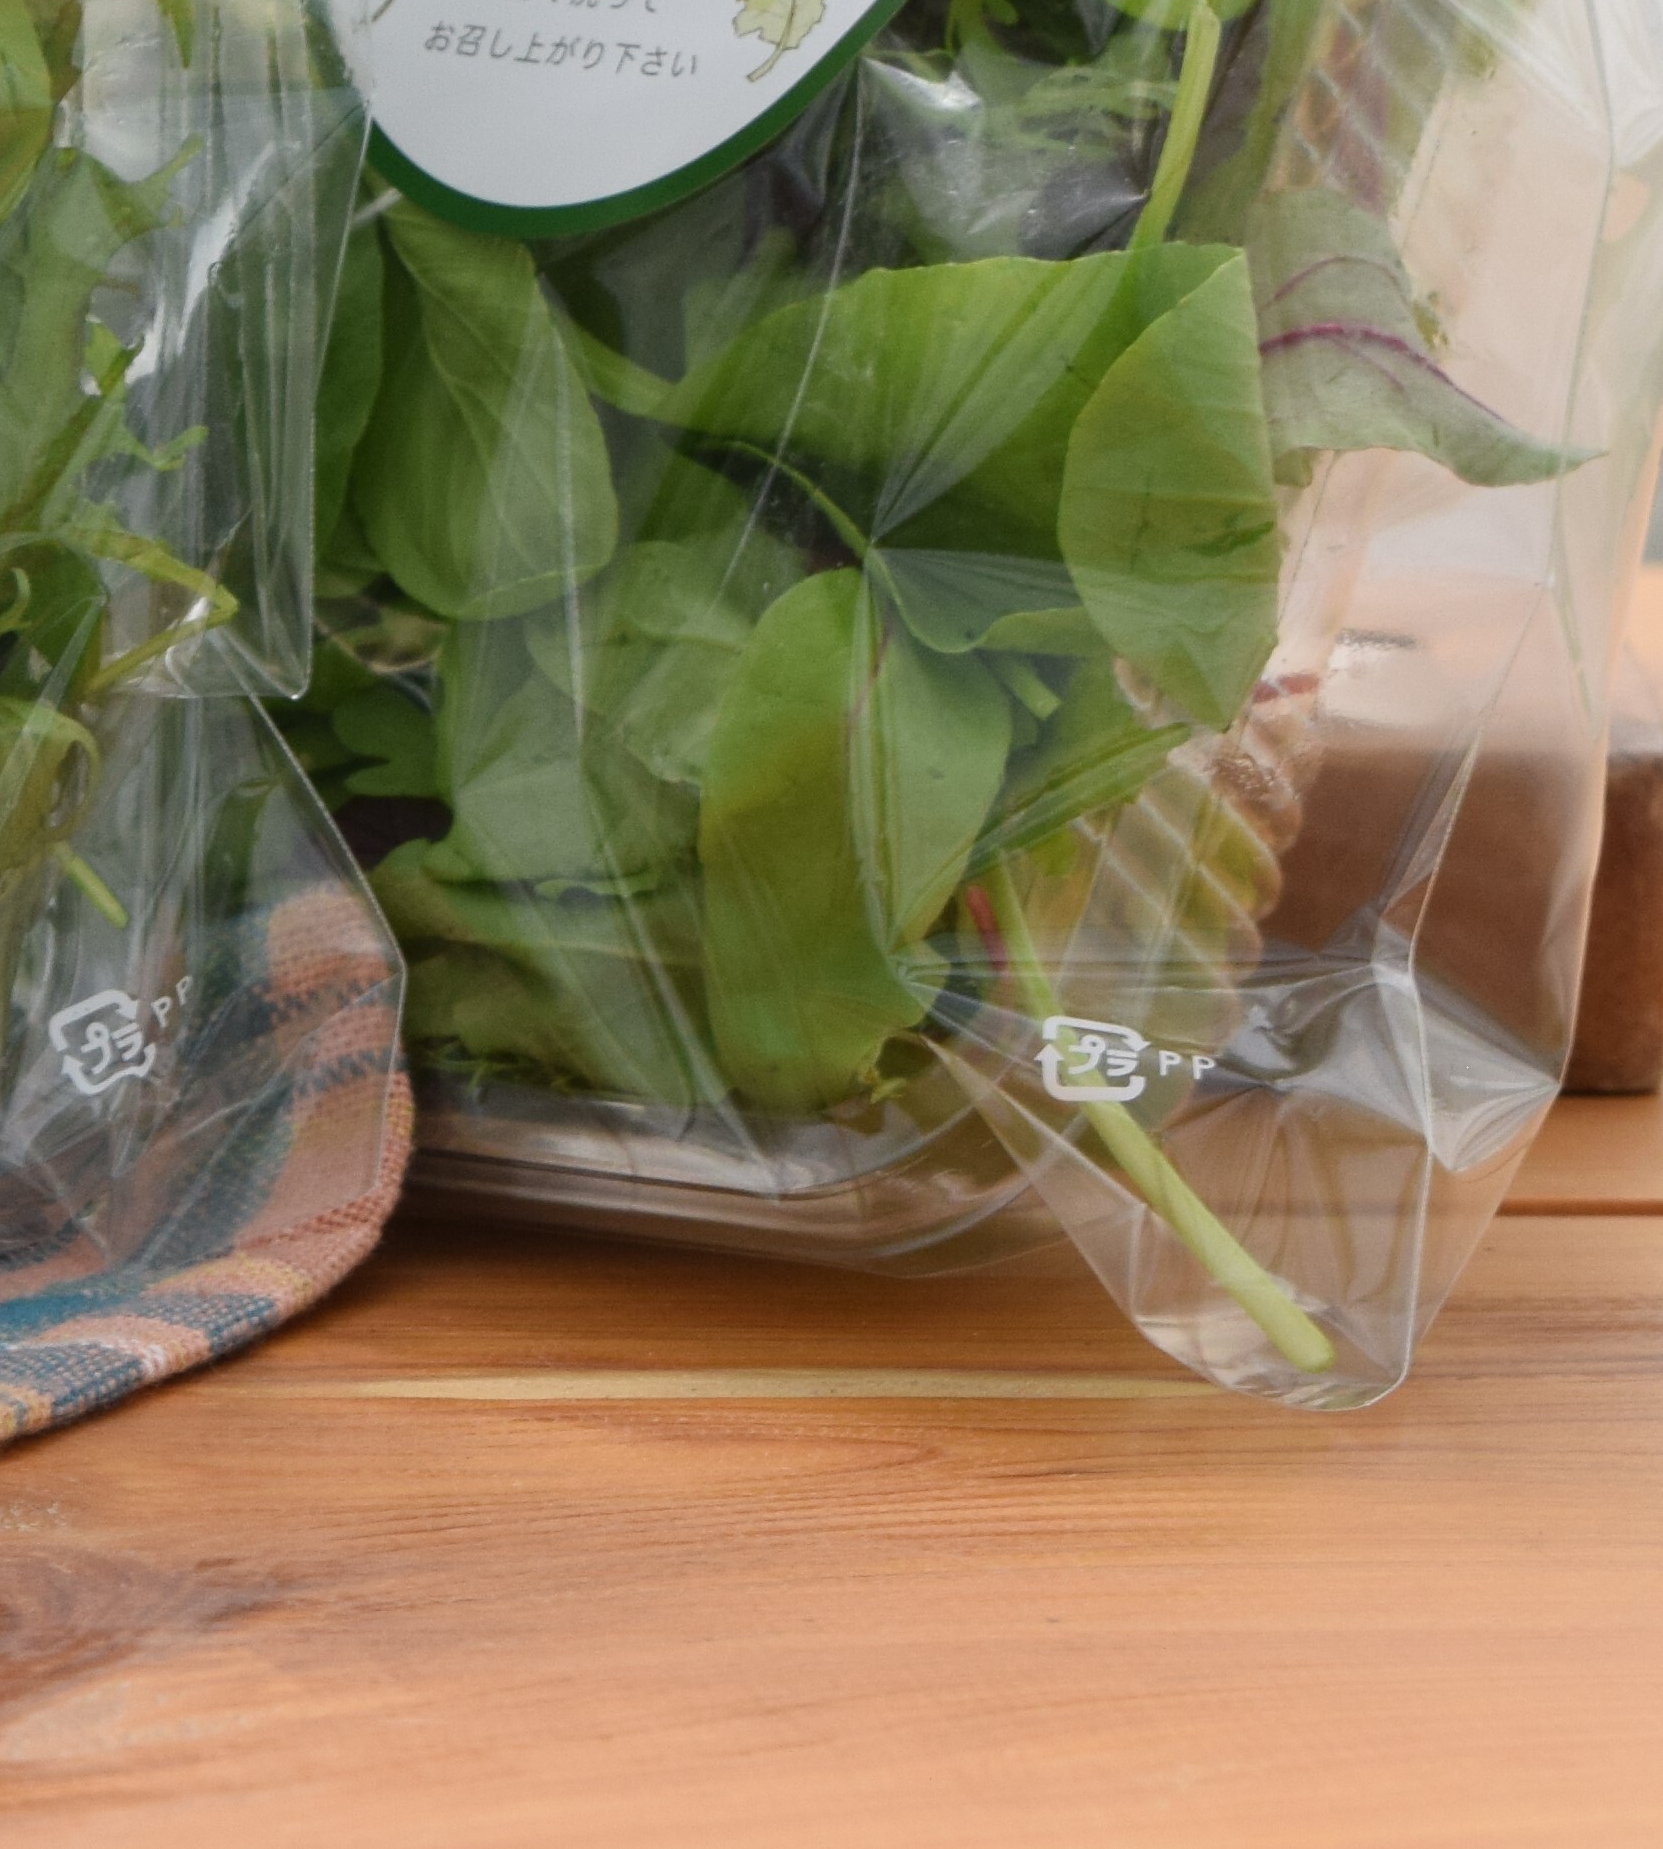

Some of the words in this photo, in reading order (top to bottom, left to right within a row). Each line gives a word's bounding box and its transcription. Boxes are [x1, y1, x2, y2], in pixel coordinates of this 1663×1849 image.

[422, 19, 698, 78] お召し上がり下さい
[81, 1021, 144, 1075] プラ
[151, 975, 194, 1028] PP
[1067, 1034, 1139, 1078] プラ
[1158, 1049, 1217, 1080] PP
